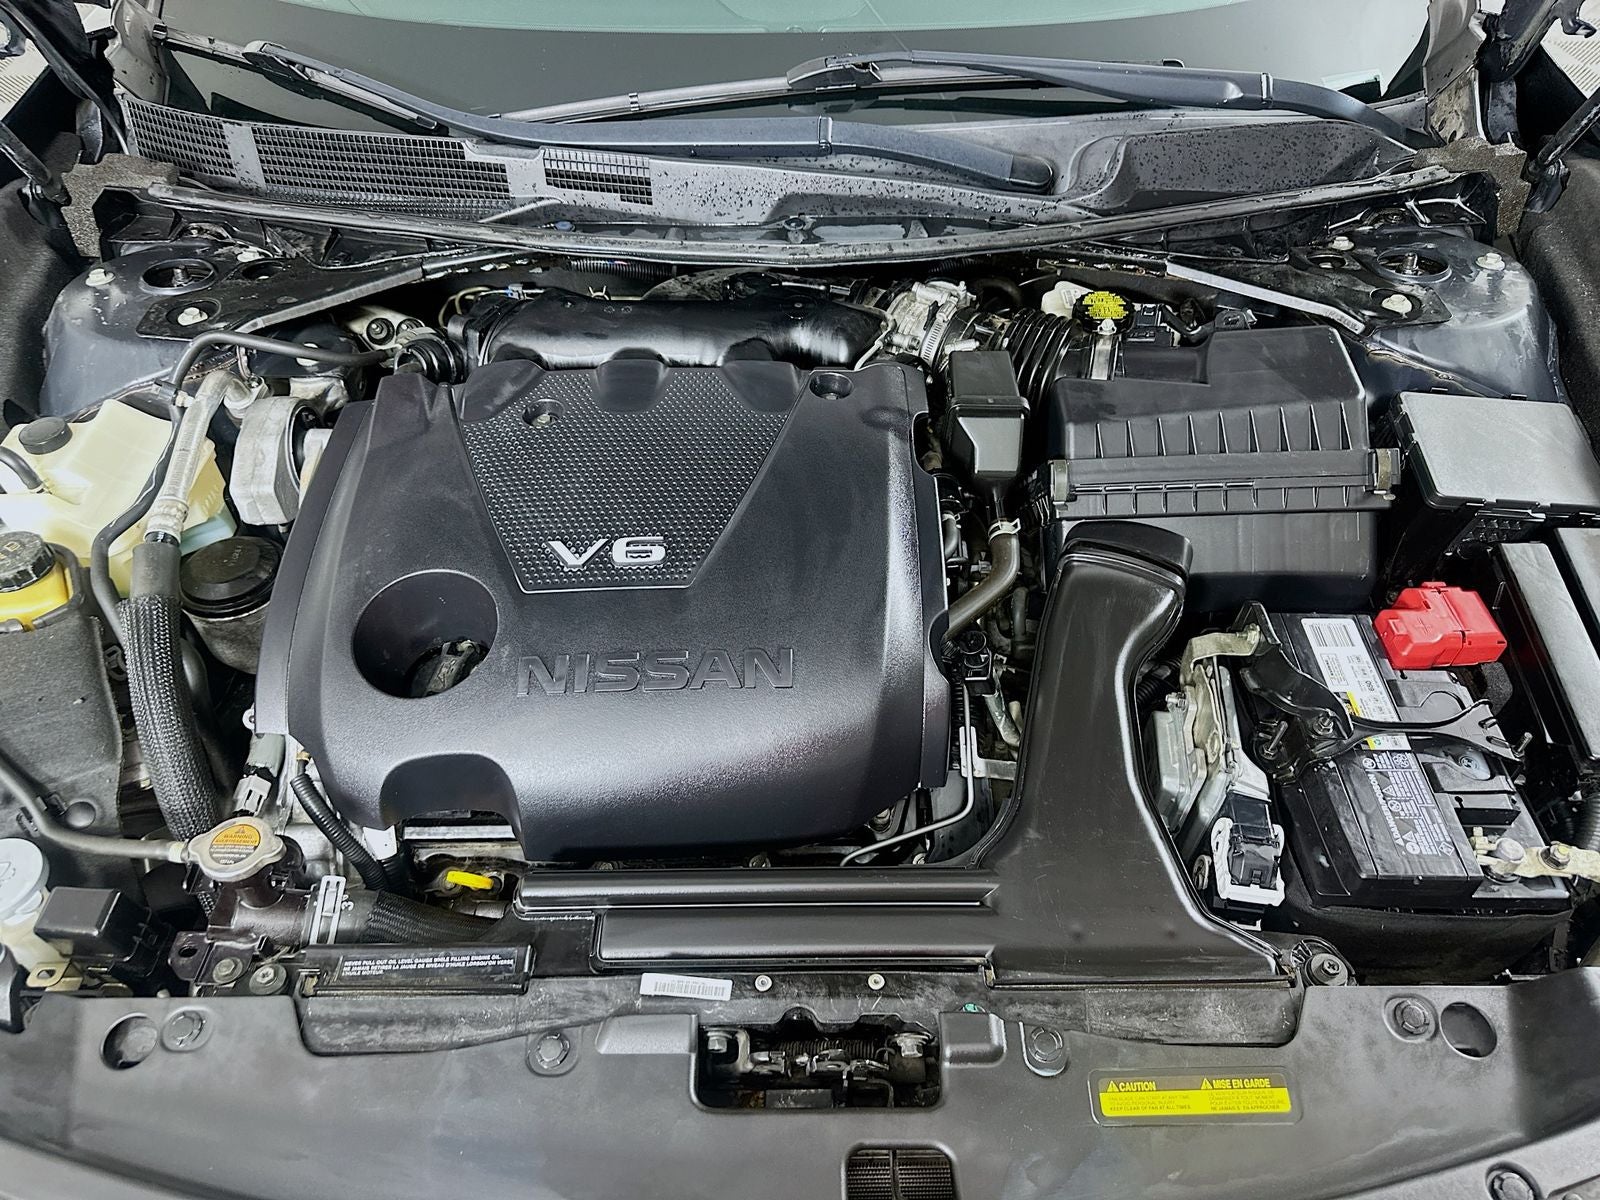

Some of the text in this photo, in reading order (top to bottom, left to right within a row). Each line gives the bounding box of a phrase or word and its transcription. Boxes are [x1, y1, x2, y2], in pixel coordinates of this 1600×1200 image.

[547, 536, 666, 568] V6
[516, 648, 793, 696] NISSAN
[1118, 1081, 1156, 1092] CAUTION
[1212, 1078, 1272, 1089] MISE EN GARDE
